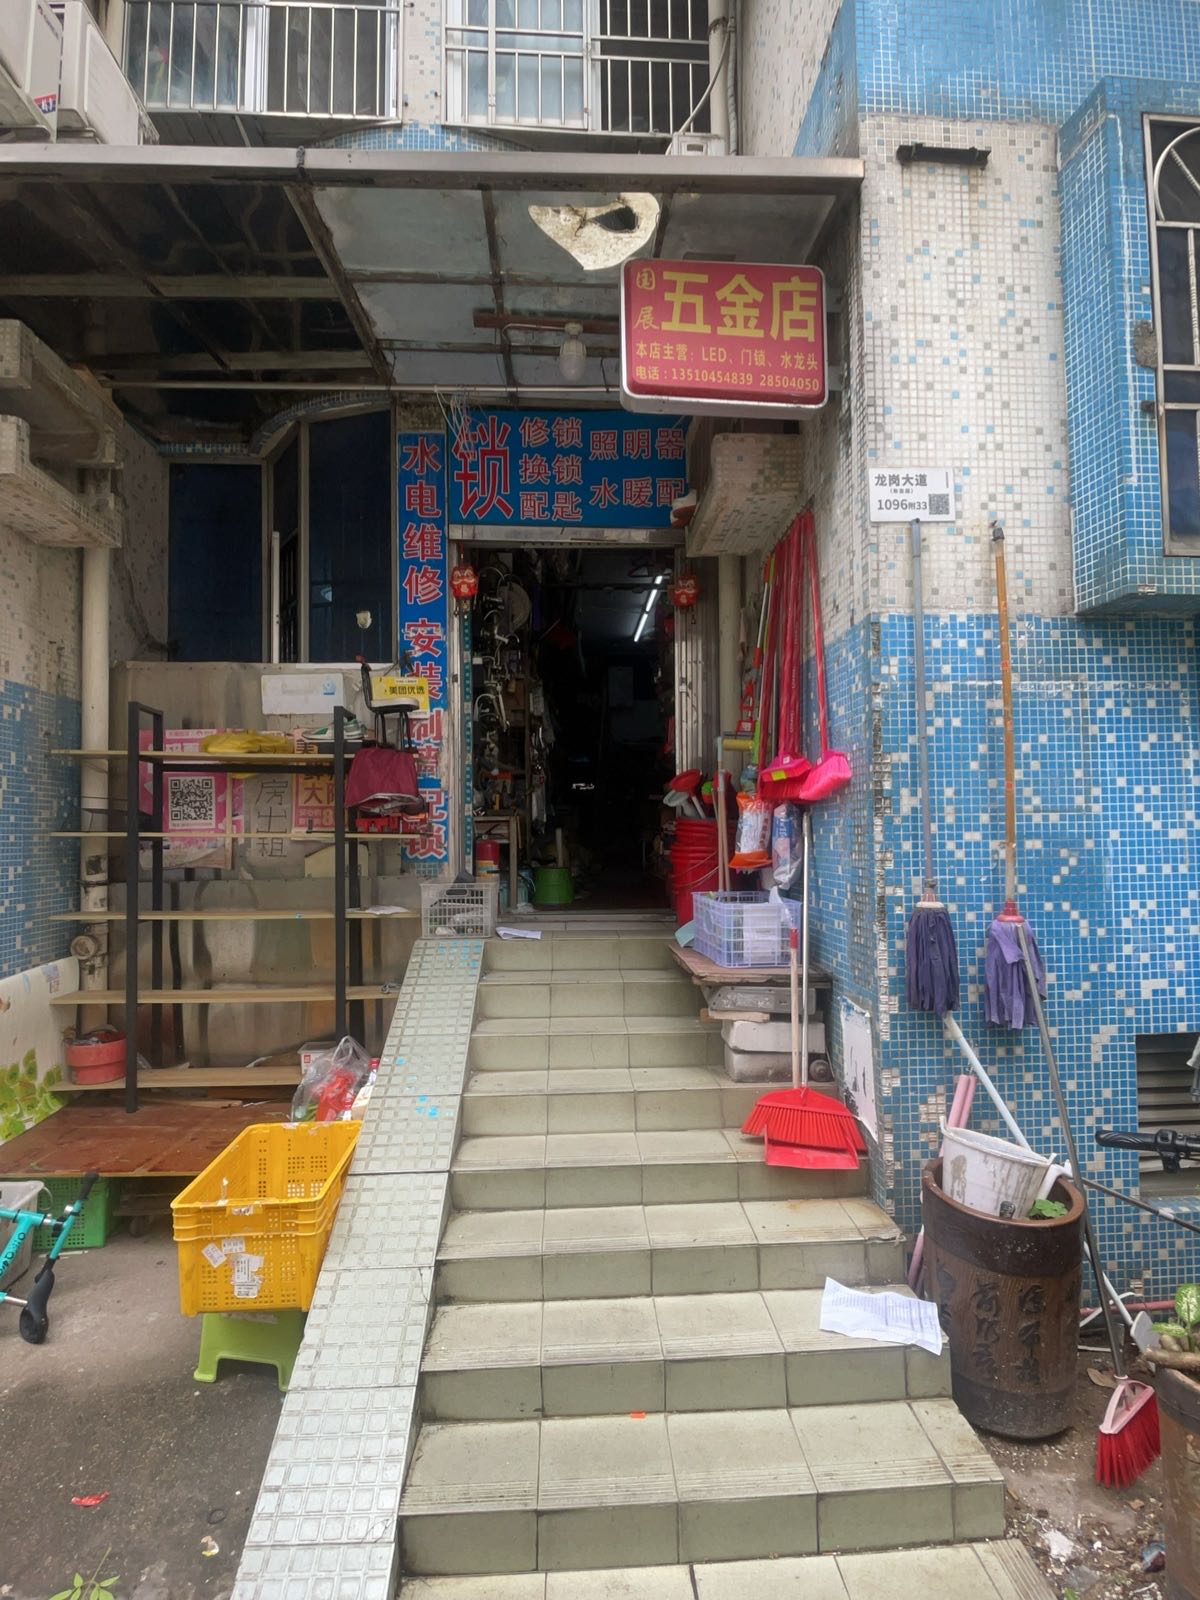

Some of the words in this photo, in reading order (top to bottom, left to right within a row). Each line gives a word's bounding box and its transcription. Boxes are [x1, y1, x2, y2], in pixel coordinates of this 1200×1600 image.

[661, 271, 818, 342] 五金店
[636, 364, 754, 386] 电话：13510454839
[759, 373, 820, 392] 28504050
[519, 416, 583, 449] 修锁
[588, 427, 686, 461] 照明器
[452, 415, 514, 520] 锁
[519, 453, 583, 486] 换锁
[874, 473, 928, 487] 龙岗大道
[519, 490, 583, 522] 配匙
[588, 476, 686, 510] 水暖配
[877, 498, 928, 511] 1096附33
[388, 685, 425, 696] 美团优选
[255, 779, 289, 858] 房出租
